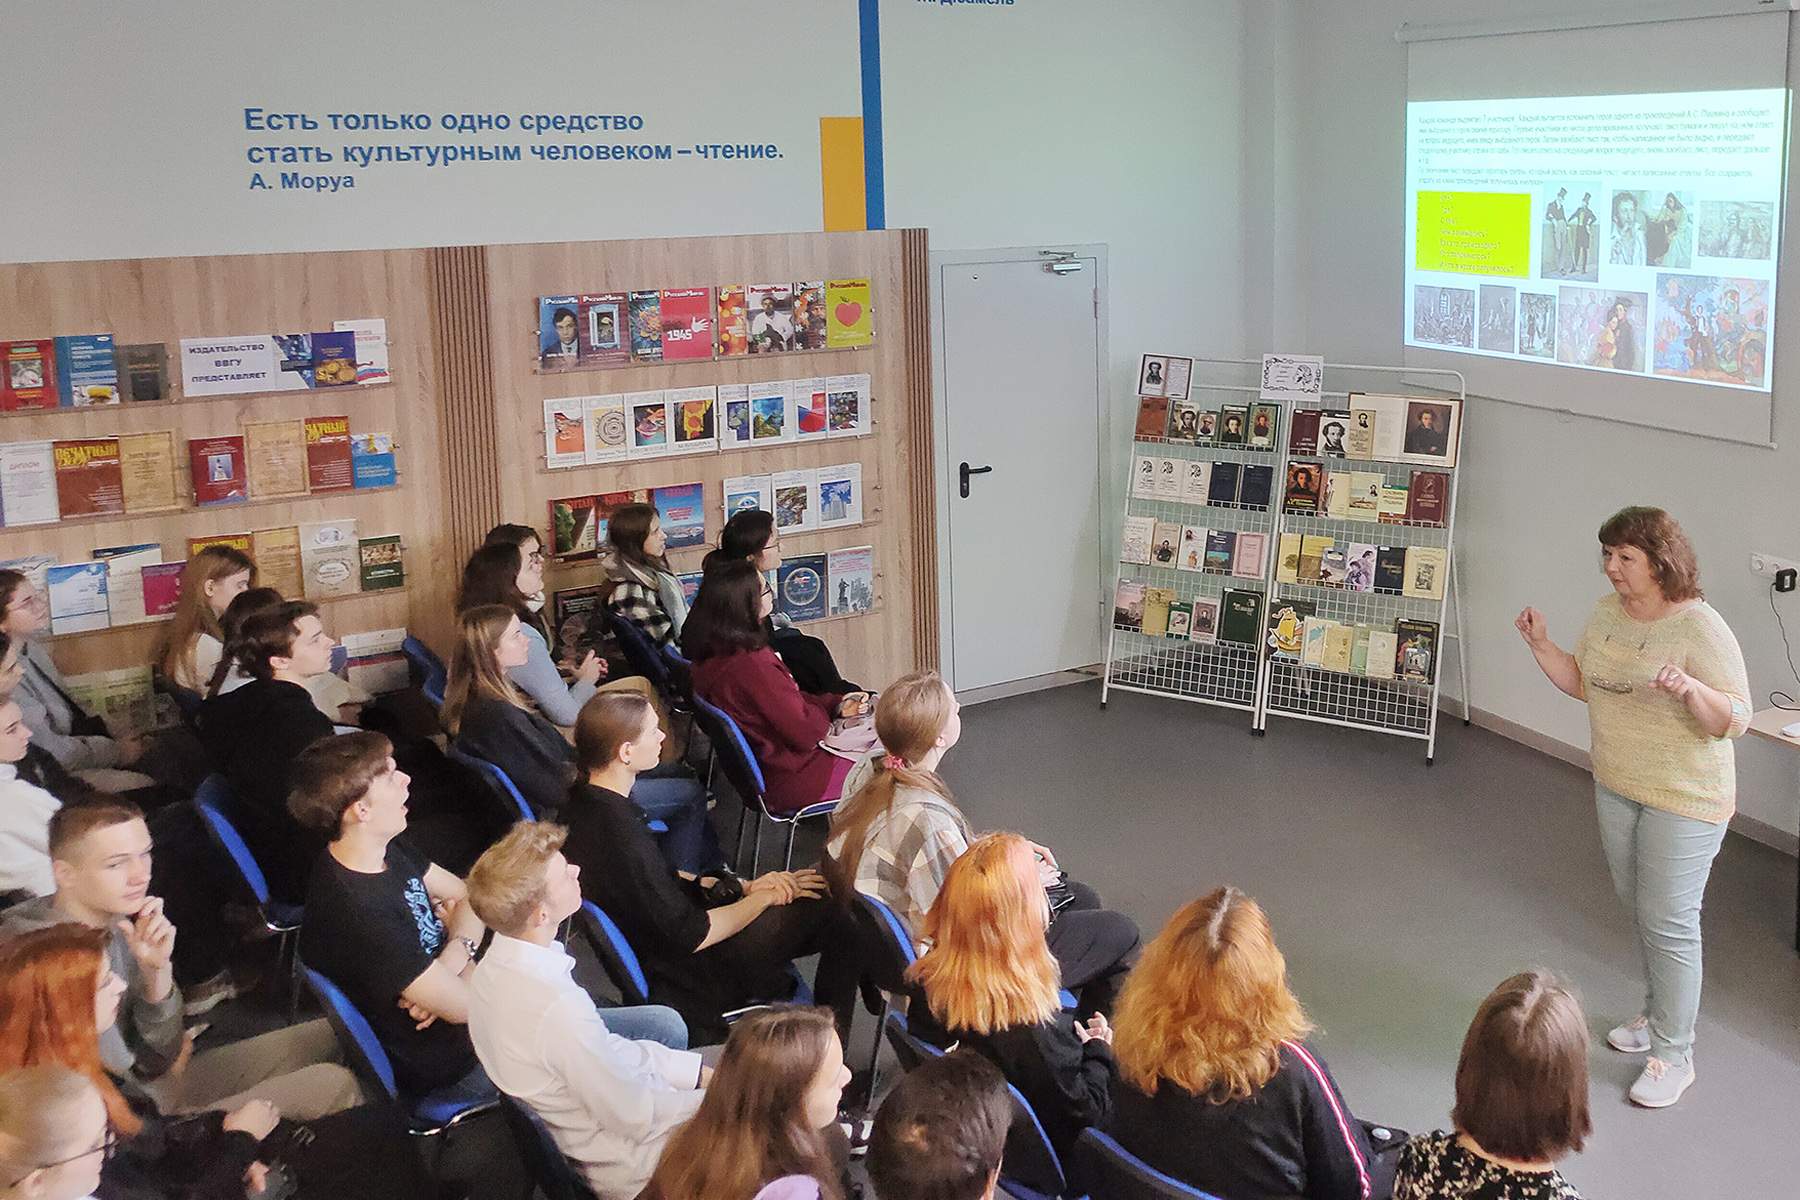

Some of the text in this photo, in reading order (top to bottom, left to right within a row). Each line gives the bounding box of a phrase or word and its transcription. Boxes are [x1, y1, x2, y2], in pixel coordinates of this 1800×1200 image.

[244, 107, 644, 135] Есть только одно средство
[247, 145, 334, 164] стать
[343, 144, 522, 168] культурным
[529, 144, 673, 161] человеком
[250, 171, 355, 193] А. Моруа
[667, 329, 693, 342] 1945
[188, 342, 266, 356] ИЗДАТЕЛЬСТВО
[213, 358, 243, 369] ВВГУ
[191, 371, 268, 385] ПРЕДСТАВЛЯЕТ
